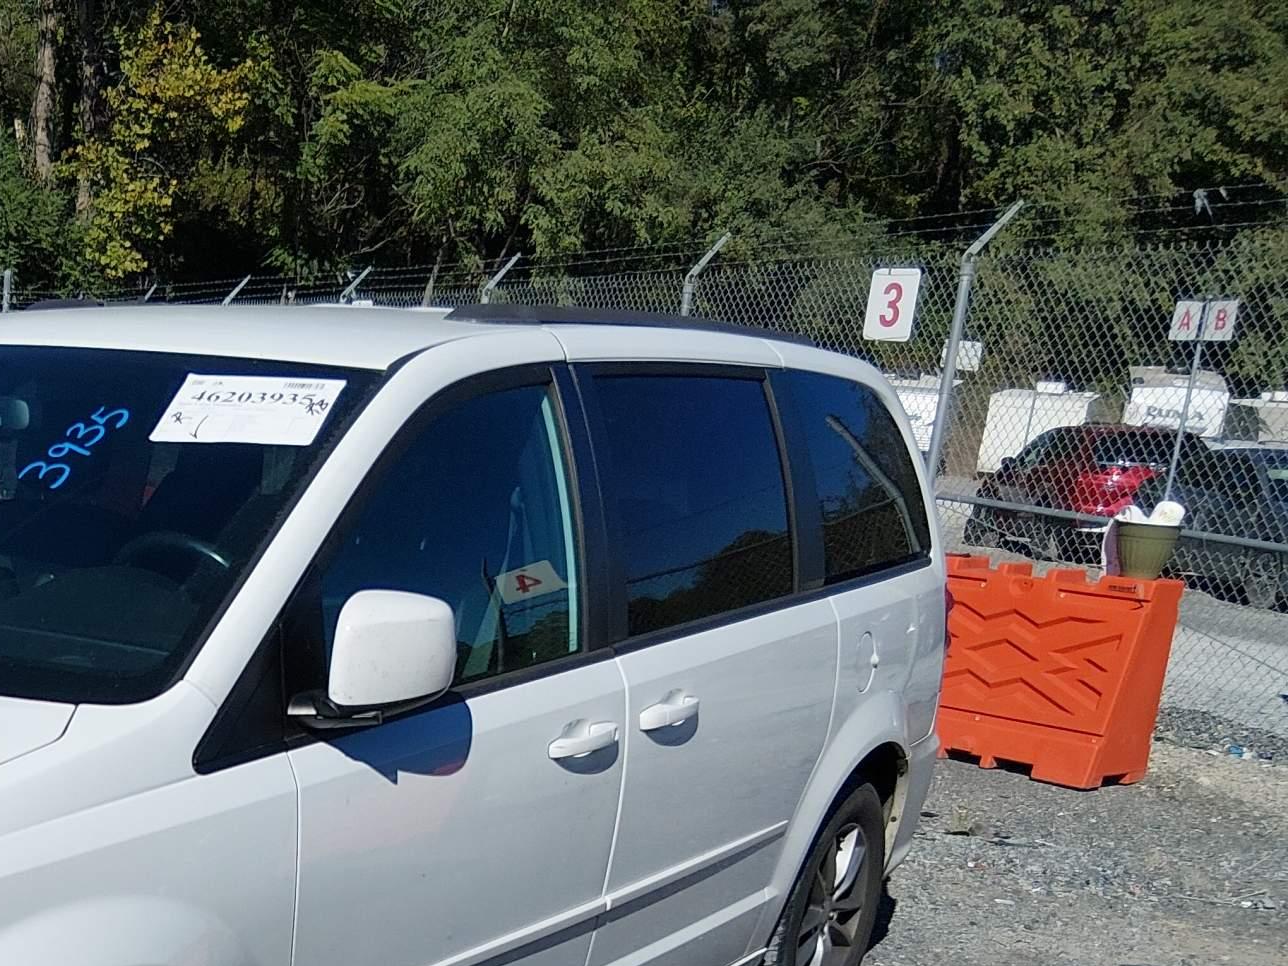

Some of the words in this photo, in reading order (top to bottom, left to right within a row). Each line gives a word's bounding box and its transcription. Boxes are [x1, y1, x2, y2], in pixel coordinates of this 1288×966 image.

[880, 282, 903, 327] 3
[1177, 308, 1192, 331] A
[1214, 308, 1228, 331] B
[191, 390, 316, 407] 46203935
[18, 405, 129, 489] 3935
